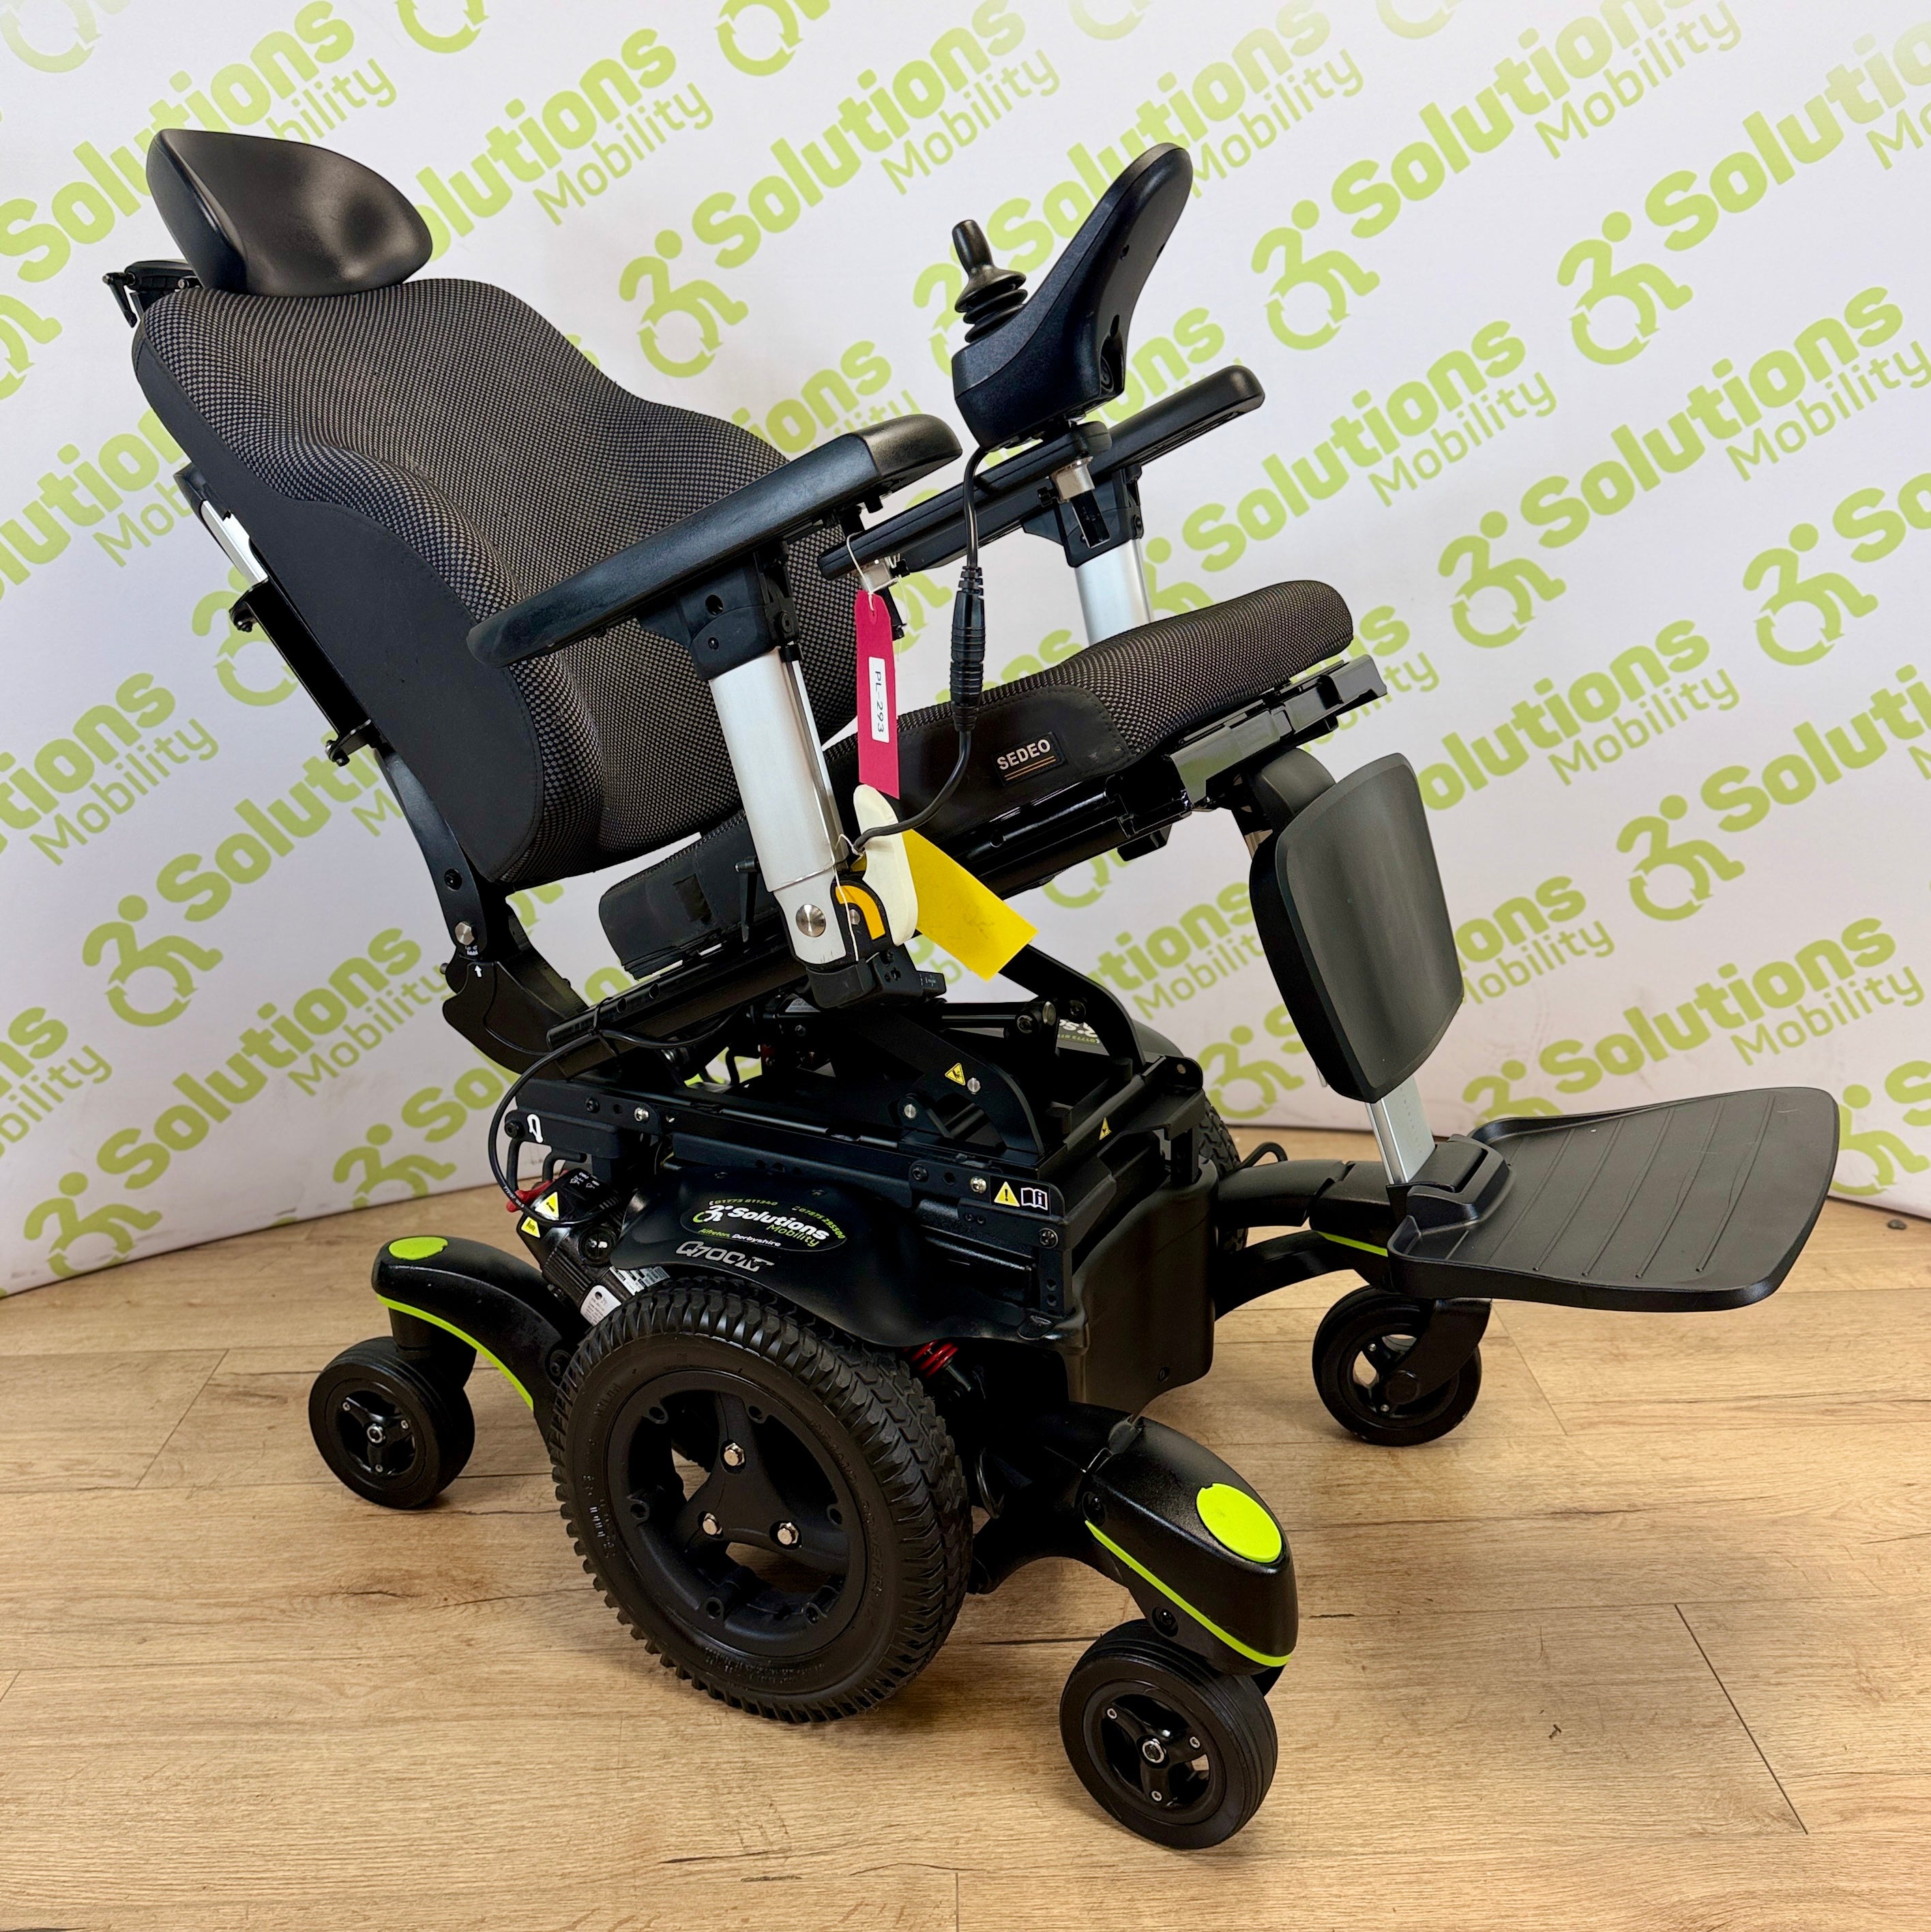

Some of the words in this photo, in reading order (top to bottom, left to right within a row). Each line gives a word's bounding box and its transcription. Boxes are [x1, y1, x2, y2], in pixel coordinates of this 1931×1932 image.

[692, 1, 1025, 269] Solutions
[881, 50, 1060, 194] Mobility
[1535, 0, 1741, 160] Mobility
[532, 82, 714, 226] Mobility
[1181, 320, 1527, 573] Solutions
[1368, 371, 1557, 507] Mobility
[1520, 286, 1904, 548] Solutions
[1726, 340, 1931, 481] Mobility
[874, 670, 885, 733] PL-293
[996, 738, 1051, 771] SEDEO
[1548, 669, 1741, 786] Mobility
[29, 719, 219, 865] Mobility
[95, 927, 422, 1190] Solutions
[1538, 917, 1897, 1094] Solutions
[1730, 966, 1925, 1066] Mobility
[726, 1206, 831, 1241] Solutions
[731, 1233, 782, 1248] Derbyshire
[765, 1223, 821, 1248] Mobility
